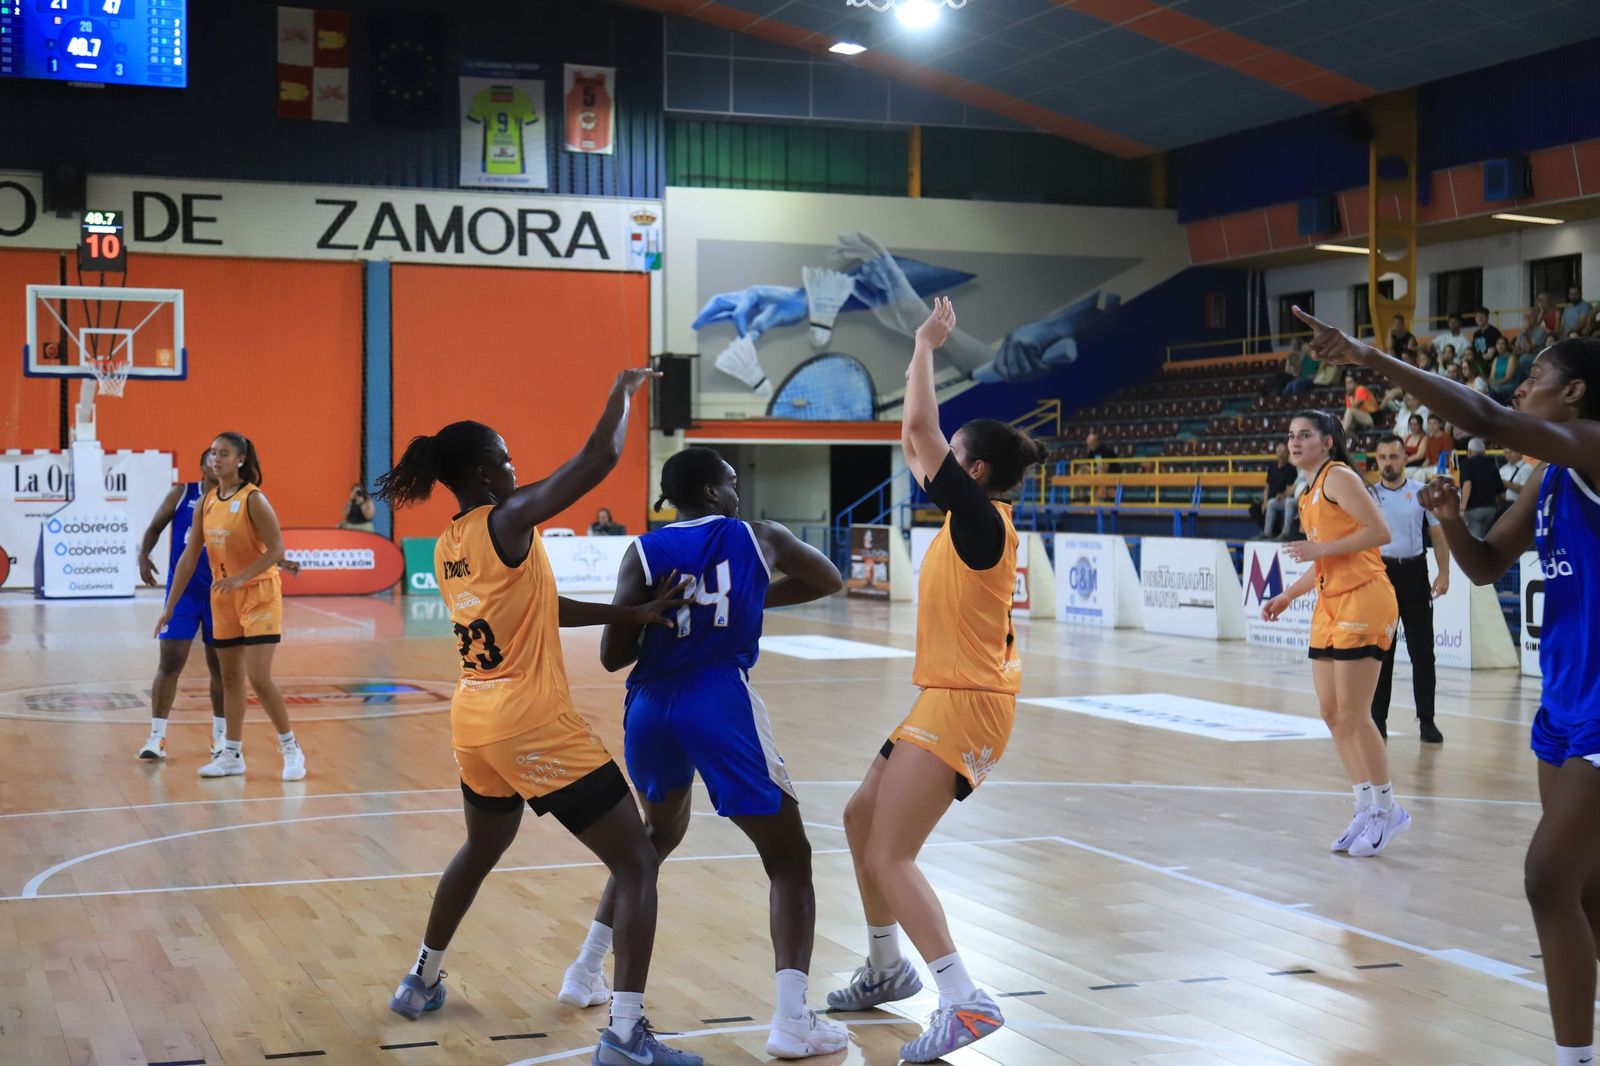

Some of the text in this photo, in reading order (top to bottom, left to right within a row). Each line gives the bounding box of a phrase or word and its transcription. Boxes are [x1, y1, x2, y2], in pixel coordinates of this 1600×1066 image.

[115, 63, 123, 76] 3
[496, 112, 508, 133] 9
[133, 190, 223, 245] DE
[315, 198, 611, 260] ZAMORA
[86, 234, 120, 259] 10
[14, 464, 39, 493] La
[63, 522, 129, 534] cobreros
[68, 545, 127, 556] cobreros
[287, 551, 372, 559] BALONCESTO
[73, 566, 119, 575] cobreros
[296, 560, 335, 568] ASTILLA
[411, 572, 440, 590] CA
[677, 559, 731, 639] 14
